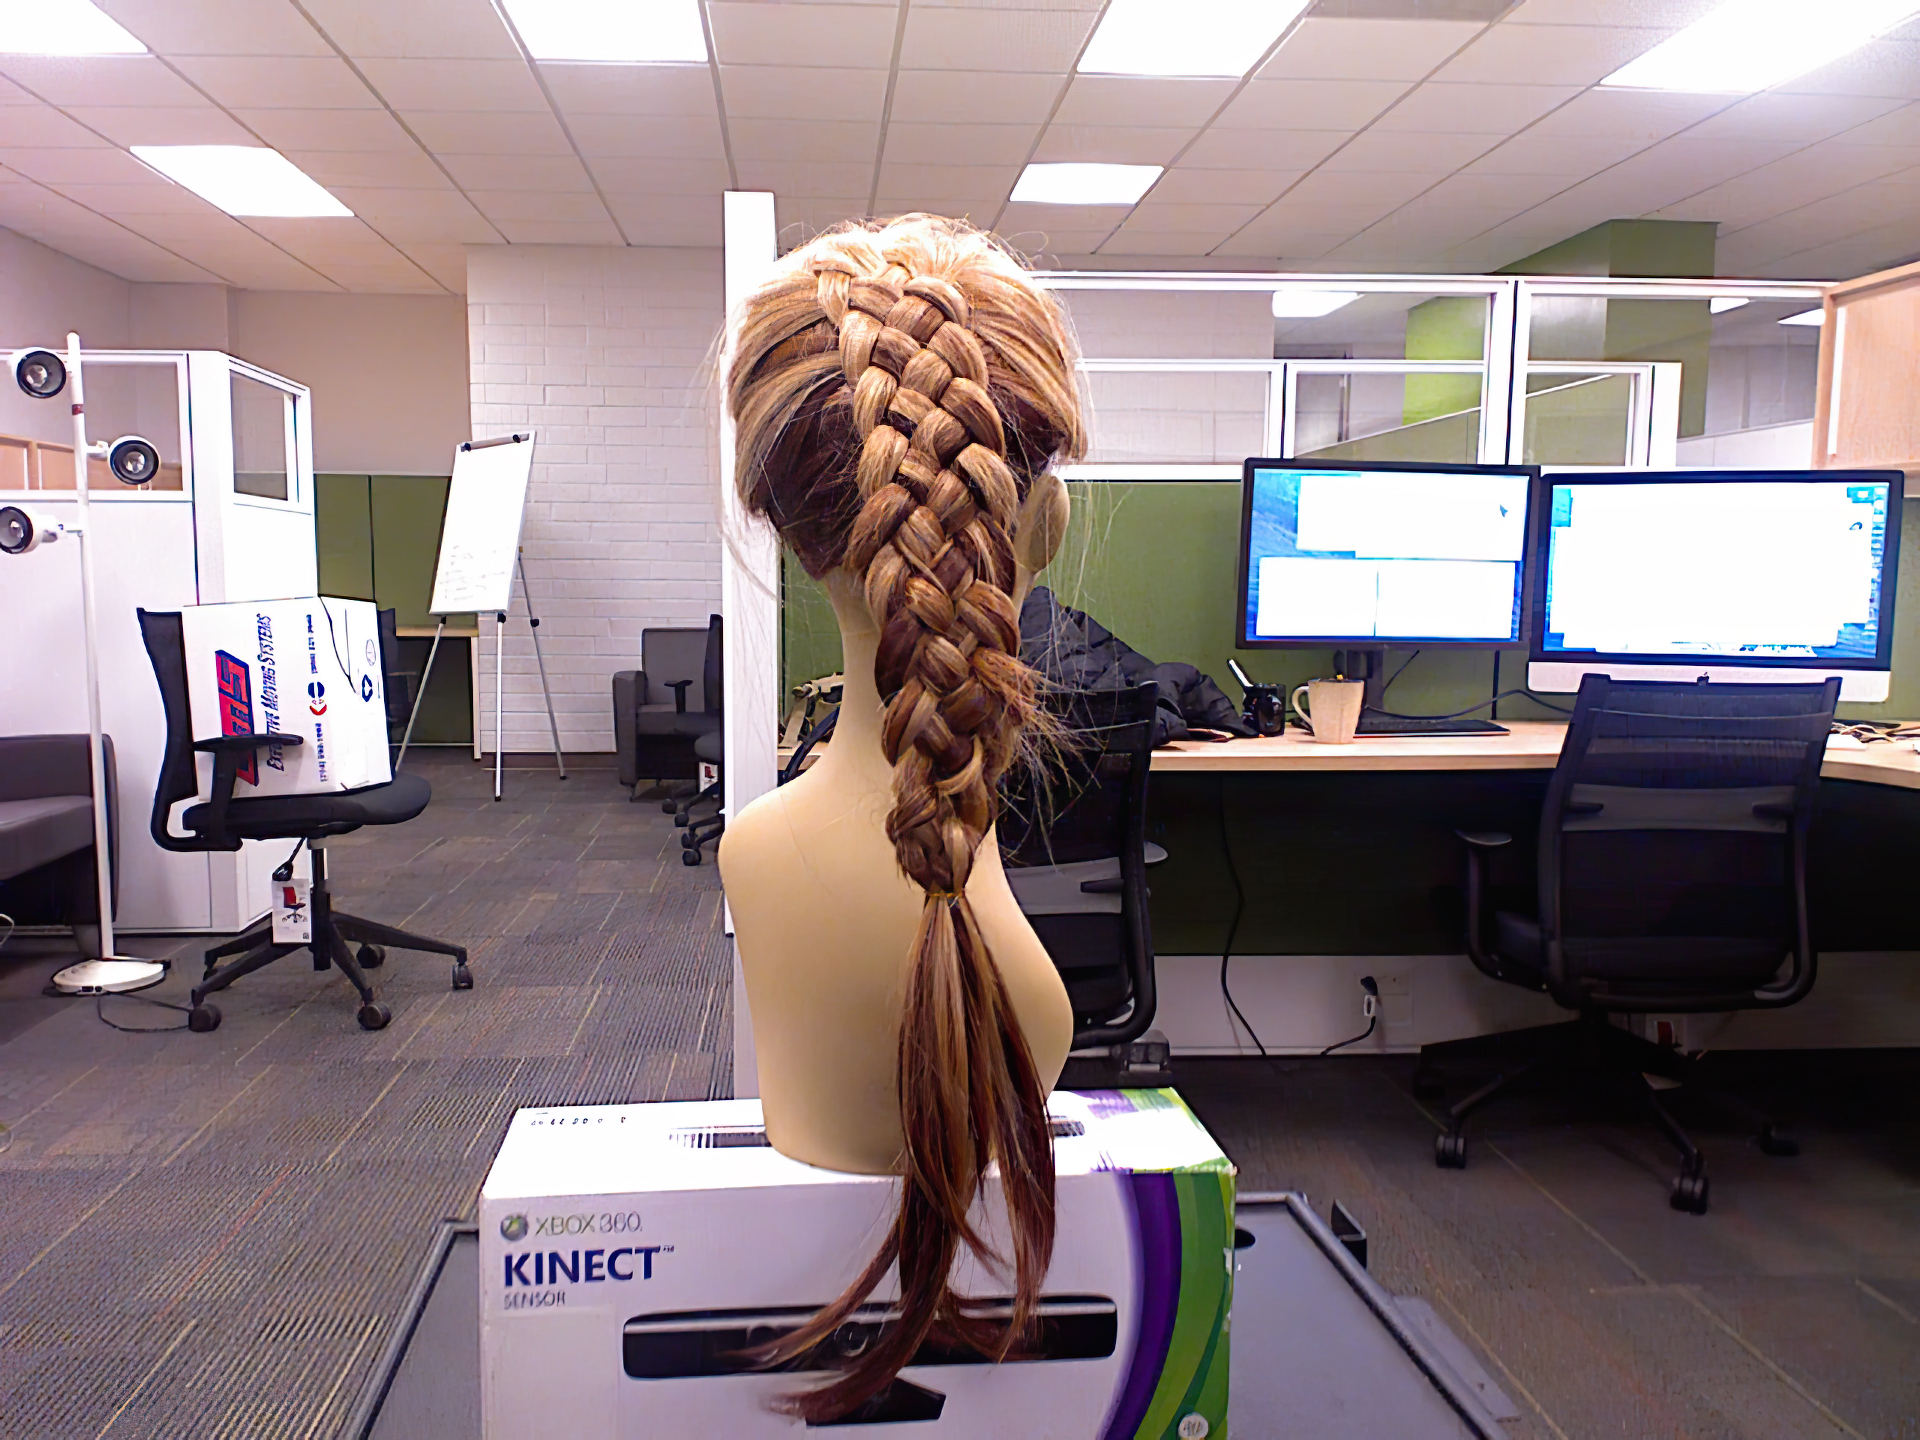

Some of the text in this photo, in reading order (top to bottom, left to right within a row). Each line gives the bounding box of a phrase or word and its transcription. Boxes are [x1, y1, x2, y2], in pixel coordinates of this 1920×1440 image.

[256, 613, 276, 665] SYSTEMS
[260, 665, 278, 711] MOVING
[535, 1211, 640, 1236] XBOX 360
[504, 1246, 660, 1287] KINECT
[503, 1290, 566, 1310] SENSOR
